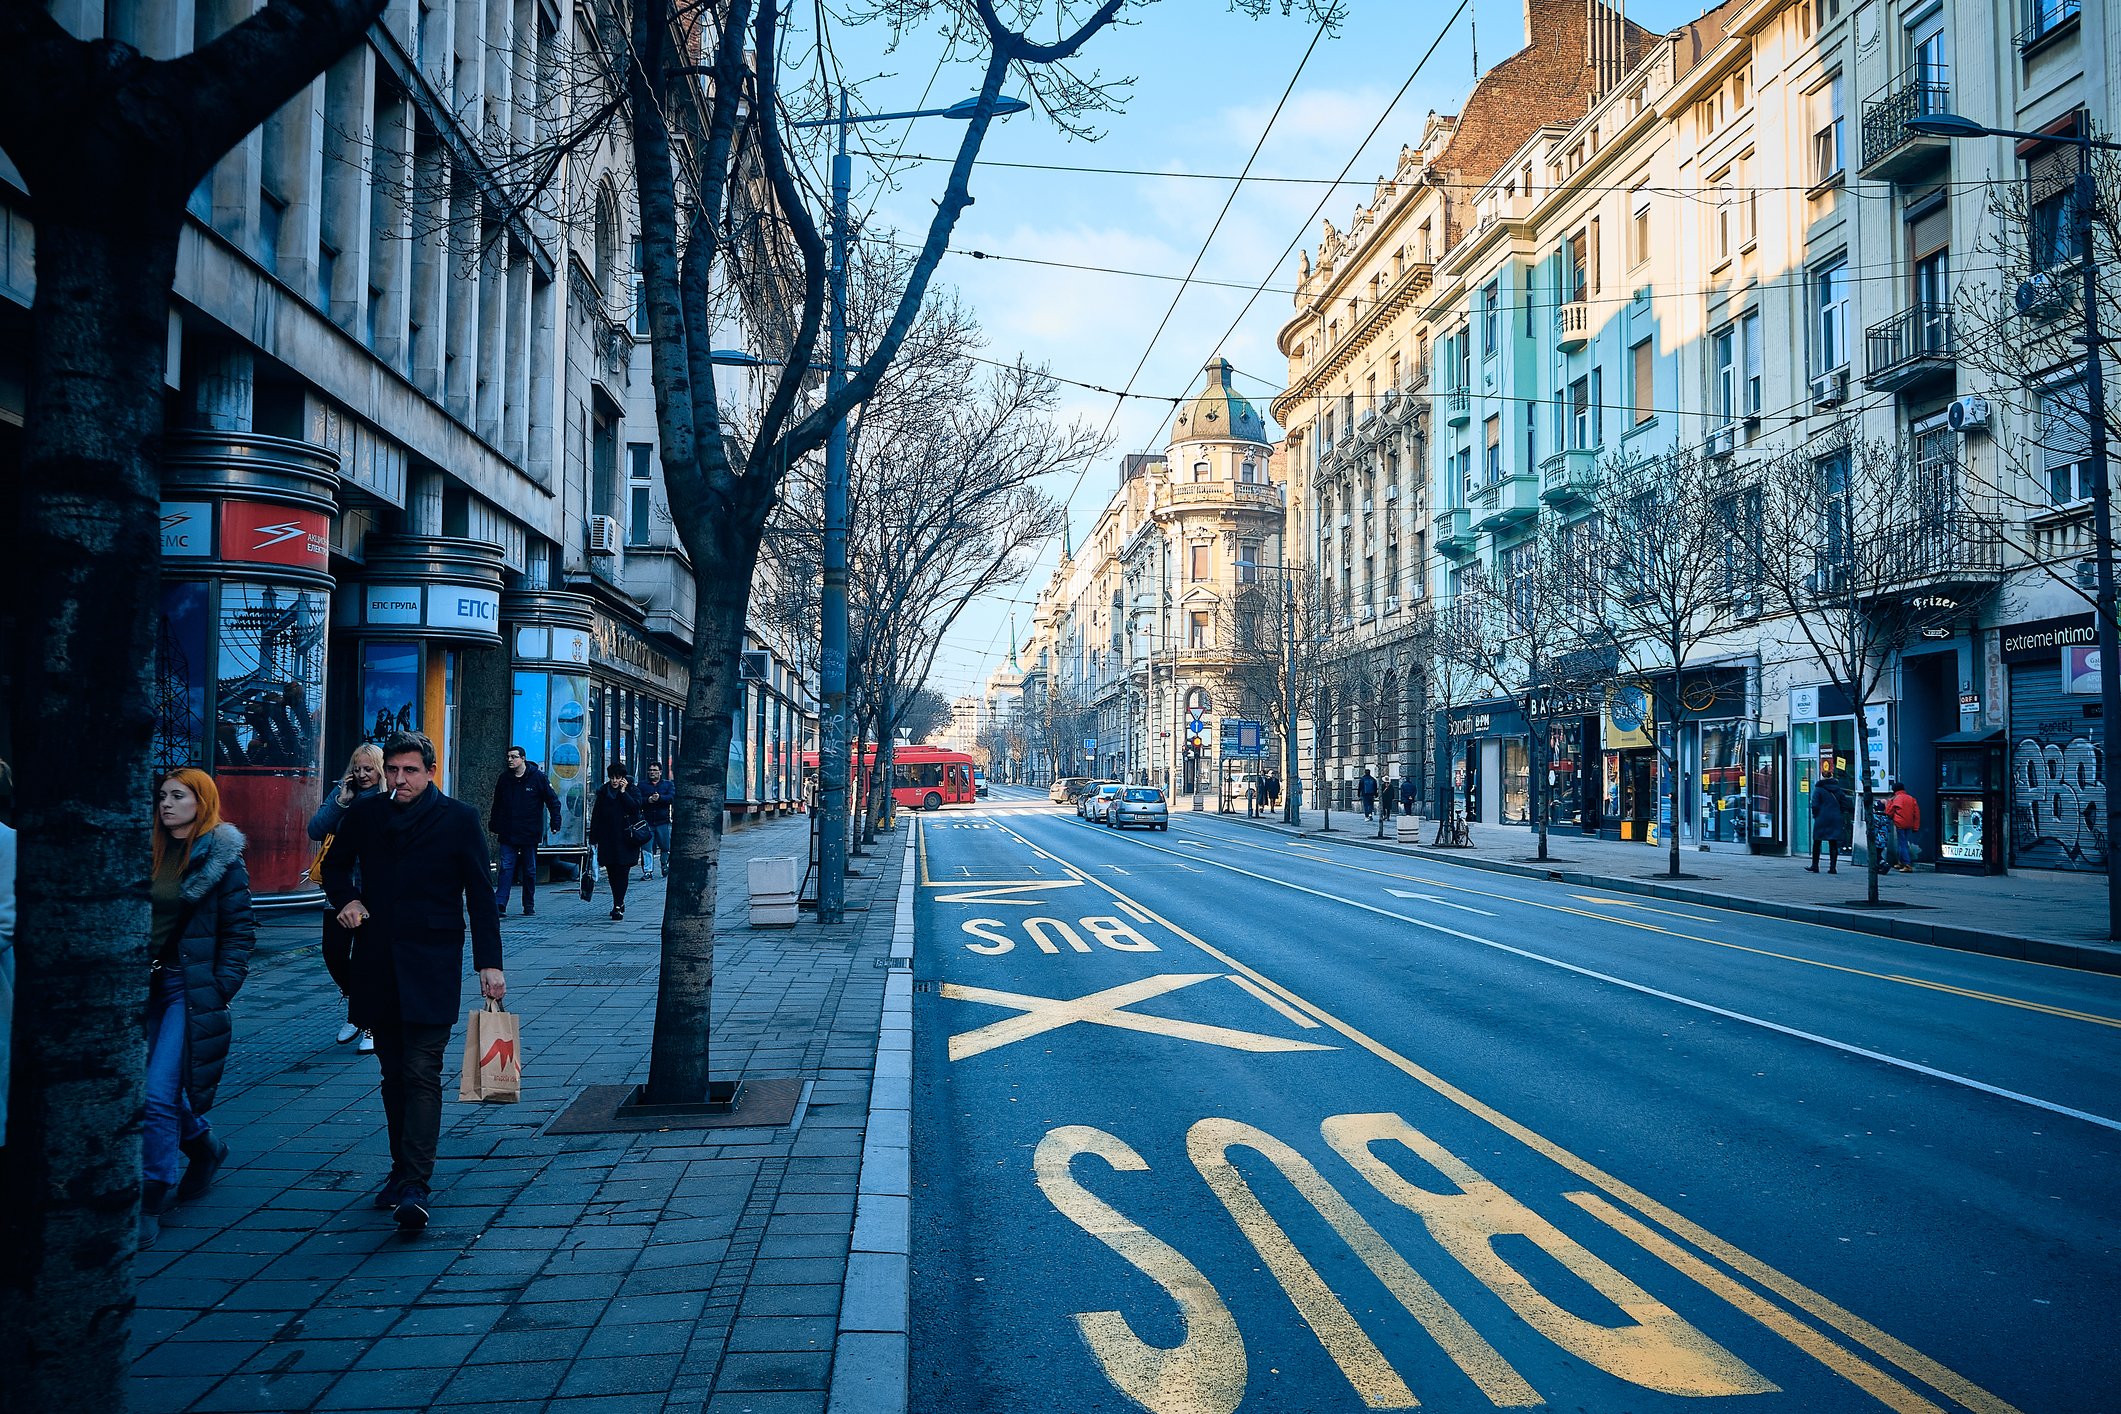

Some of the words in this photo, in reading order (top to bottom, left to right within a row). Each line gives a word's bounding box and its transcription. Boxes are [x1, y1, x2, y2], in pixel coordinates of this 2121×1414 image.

[372, 601, 389, 610] ЕПС
[390, 601, 418, 611] ГРУПА
[457, 598, 489, 620] ЕПС
[2005, 631, 2053, 652] extreme
[2054, 626, 2095, 646] intimo
[961, 915, 1163, 956] BUS
[1032, 1110, 1785, 1414] BUS
